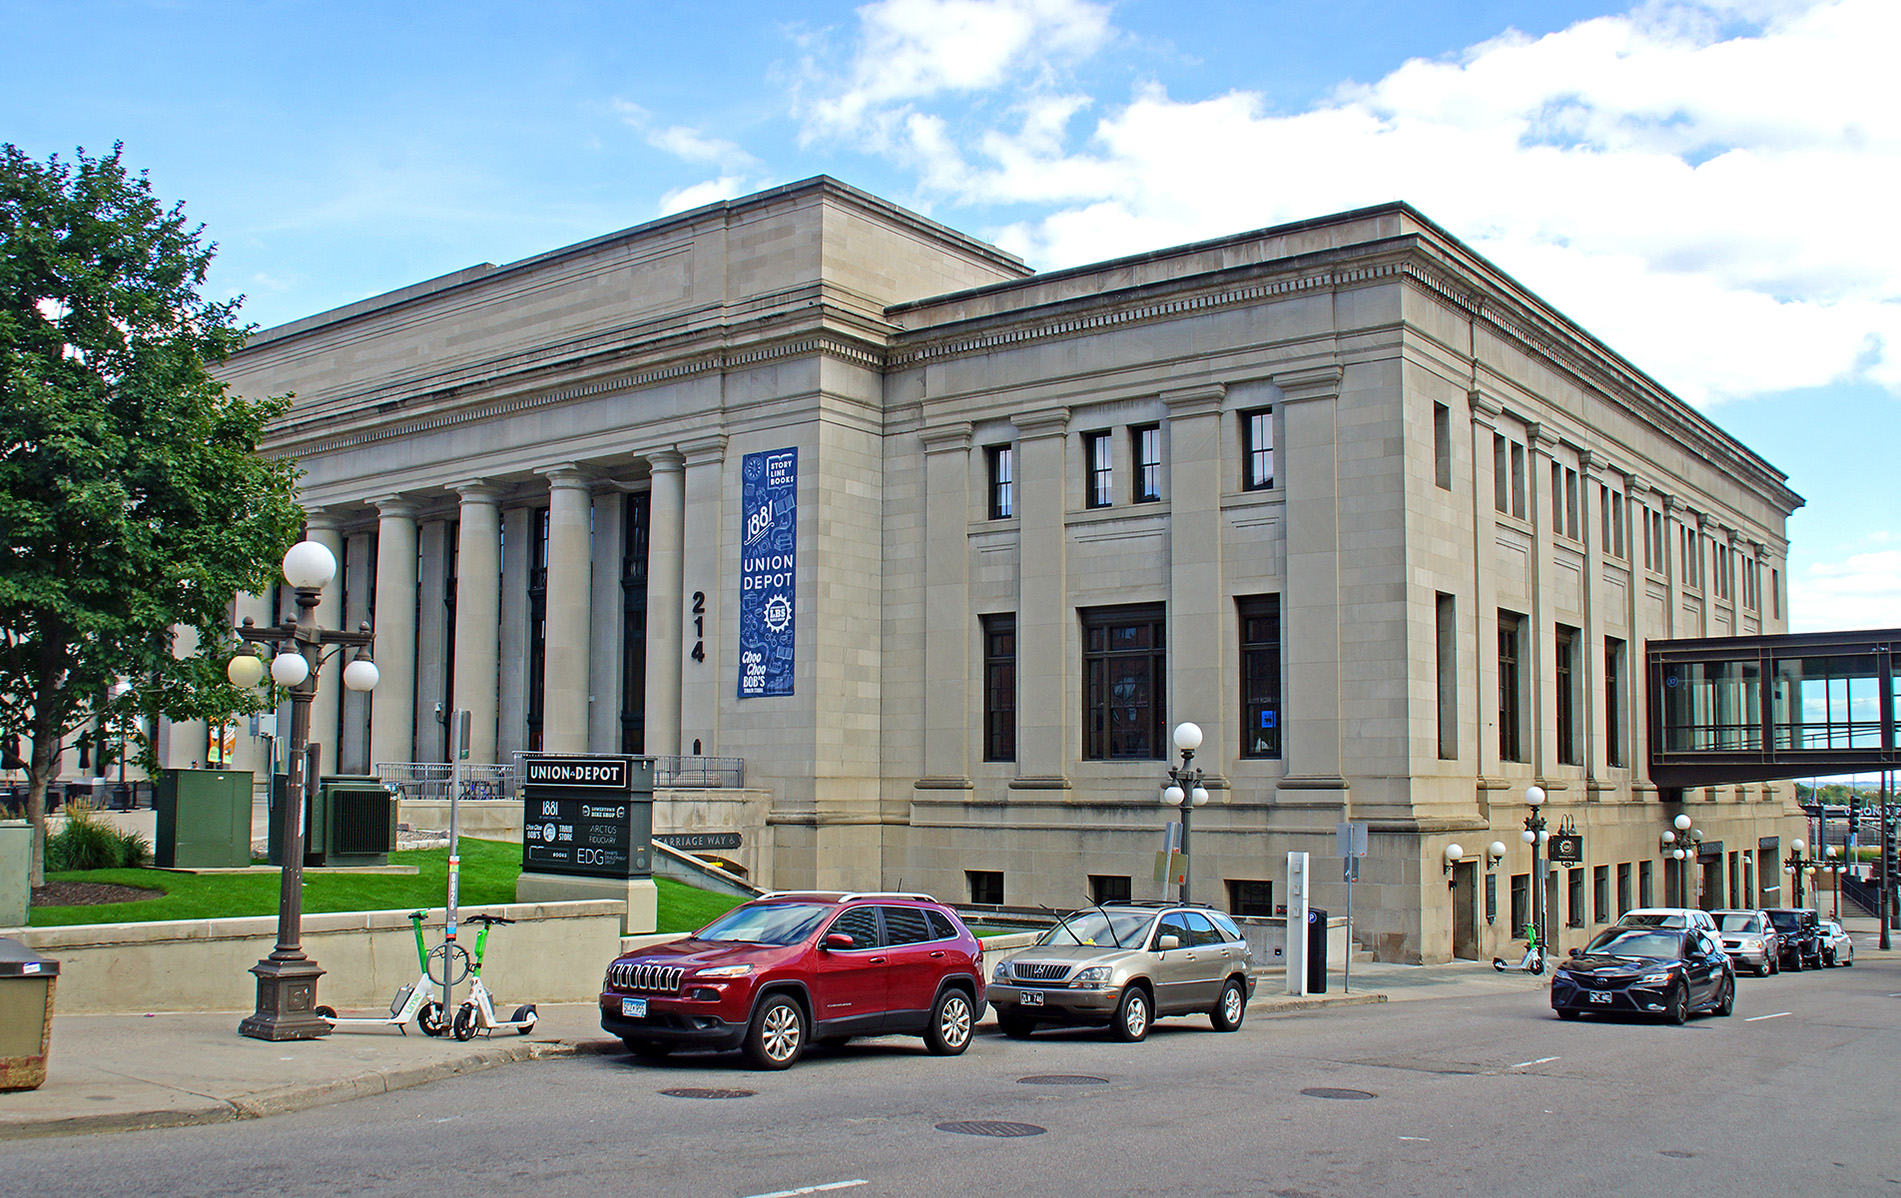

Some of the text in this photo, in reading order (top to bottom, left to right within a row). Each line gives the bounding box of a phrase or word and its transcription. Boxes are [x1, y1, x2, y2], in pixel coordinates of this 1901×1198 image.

[770, 460, 793, 470] STORY
[770, 469, 786, 478] LINE
[770, 475, 794, 486] BOOKS
[746, 499, 773, 541] 1881
[744, 553, 794, 573] UNION
[743, 572, 793, 591] DEPOT
[769, 608, 786, 619] LBS
[691, 590, 706, 663] 214
[742, 651, 762, 664] Choo
[746, 663, 767, 676] Choo
[743, 675, 766, 688] BOB'S
[530, 765, 620, 781] UNION DEPOT
[542, 800, 559, 816] 1881
[589, 825, 618, 834] ARCTOS
[558, 832, 573, 842] STORE
[707, 836, 726, 846] WAY
[577, 847, 604, 866] EDG
[449, 872, 457, 911] 8026
